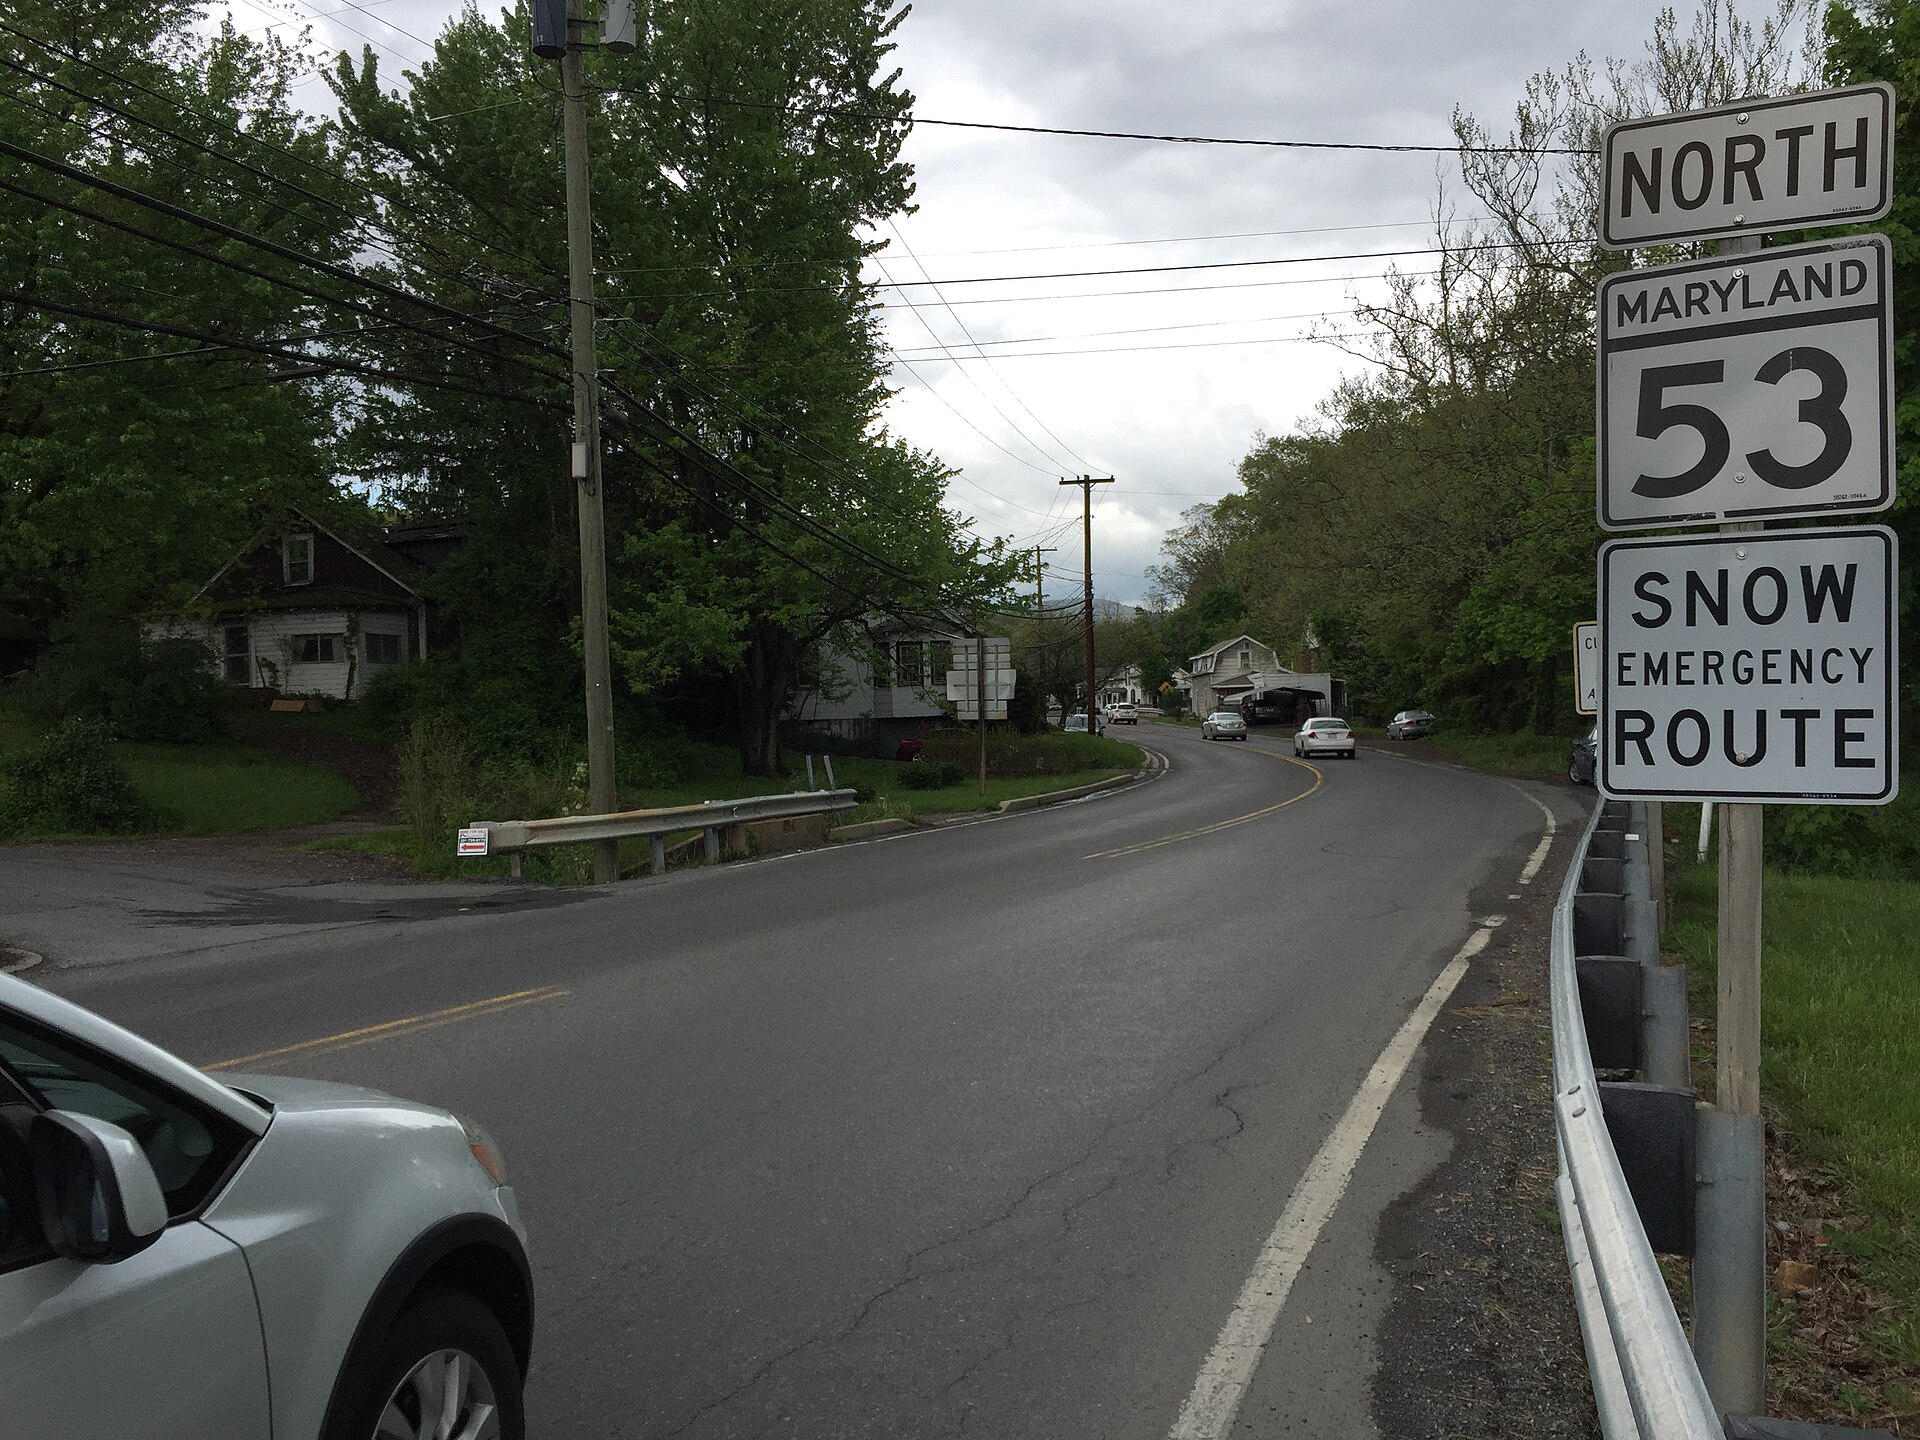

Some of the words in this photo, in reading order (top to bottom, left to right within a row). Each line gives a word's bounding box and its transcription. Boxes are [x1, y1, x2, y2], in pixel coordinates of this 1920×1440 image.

[1621, 117, 1868, 218] NORTH
[1617, 259, 1867, 327] MARYLAND
[1631, 347, 1852, 498] 53
[1631, 563, 1858, 628] SNOW
[1618, 648, 1873, 686] EMERGENCY
[1615, 709, 1875, 768] ROUTE
